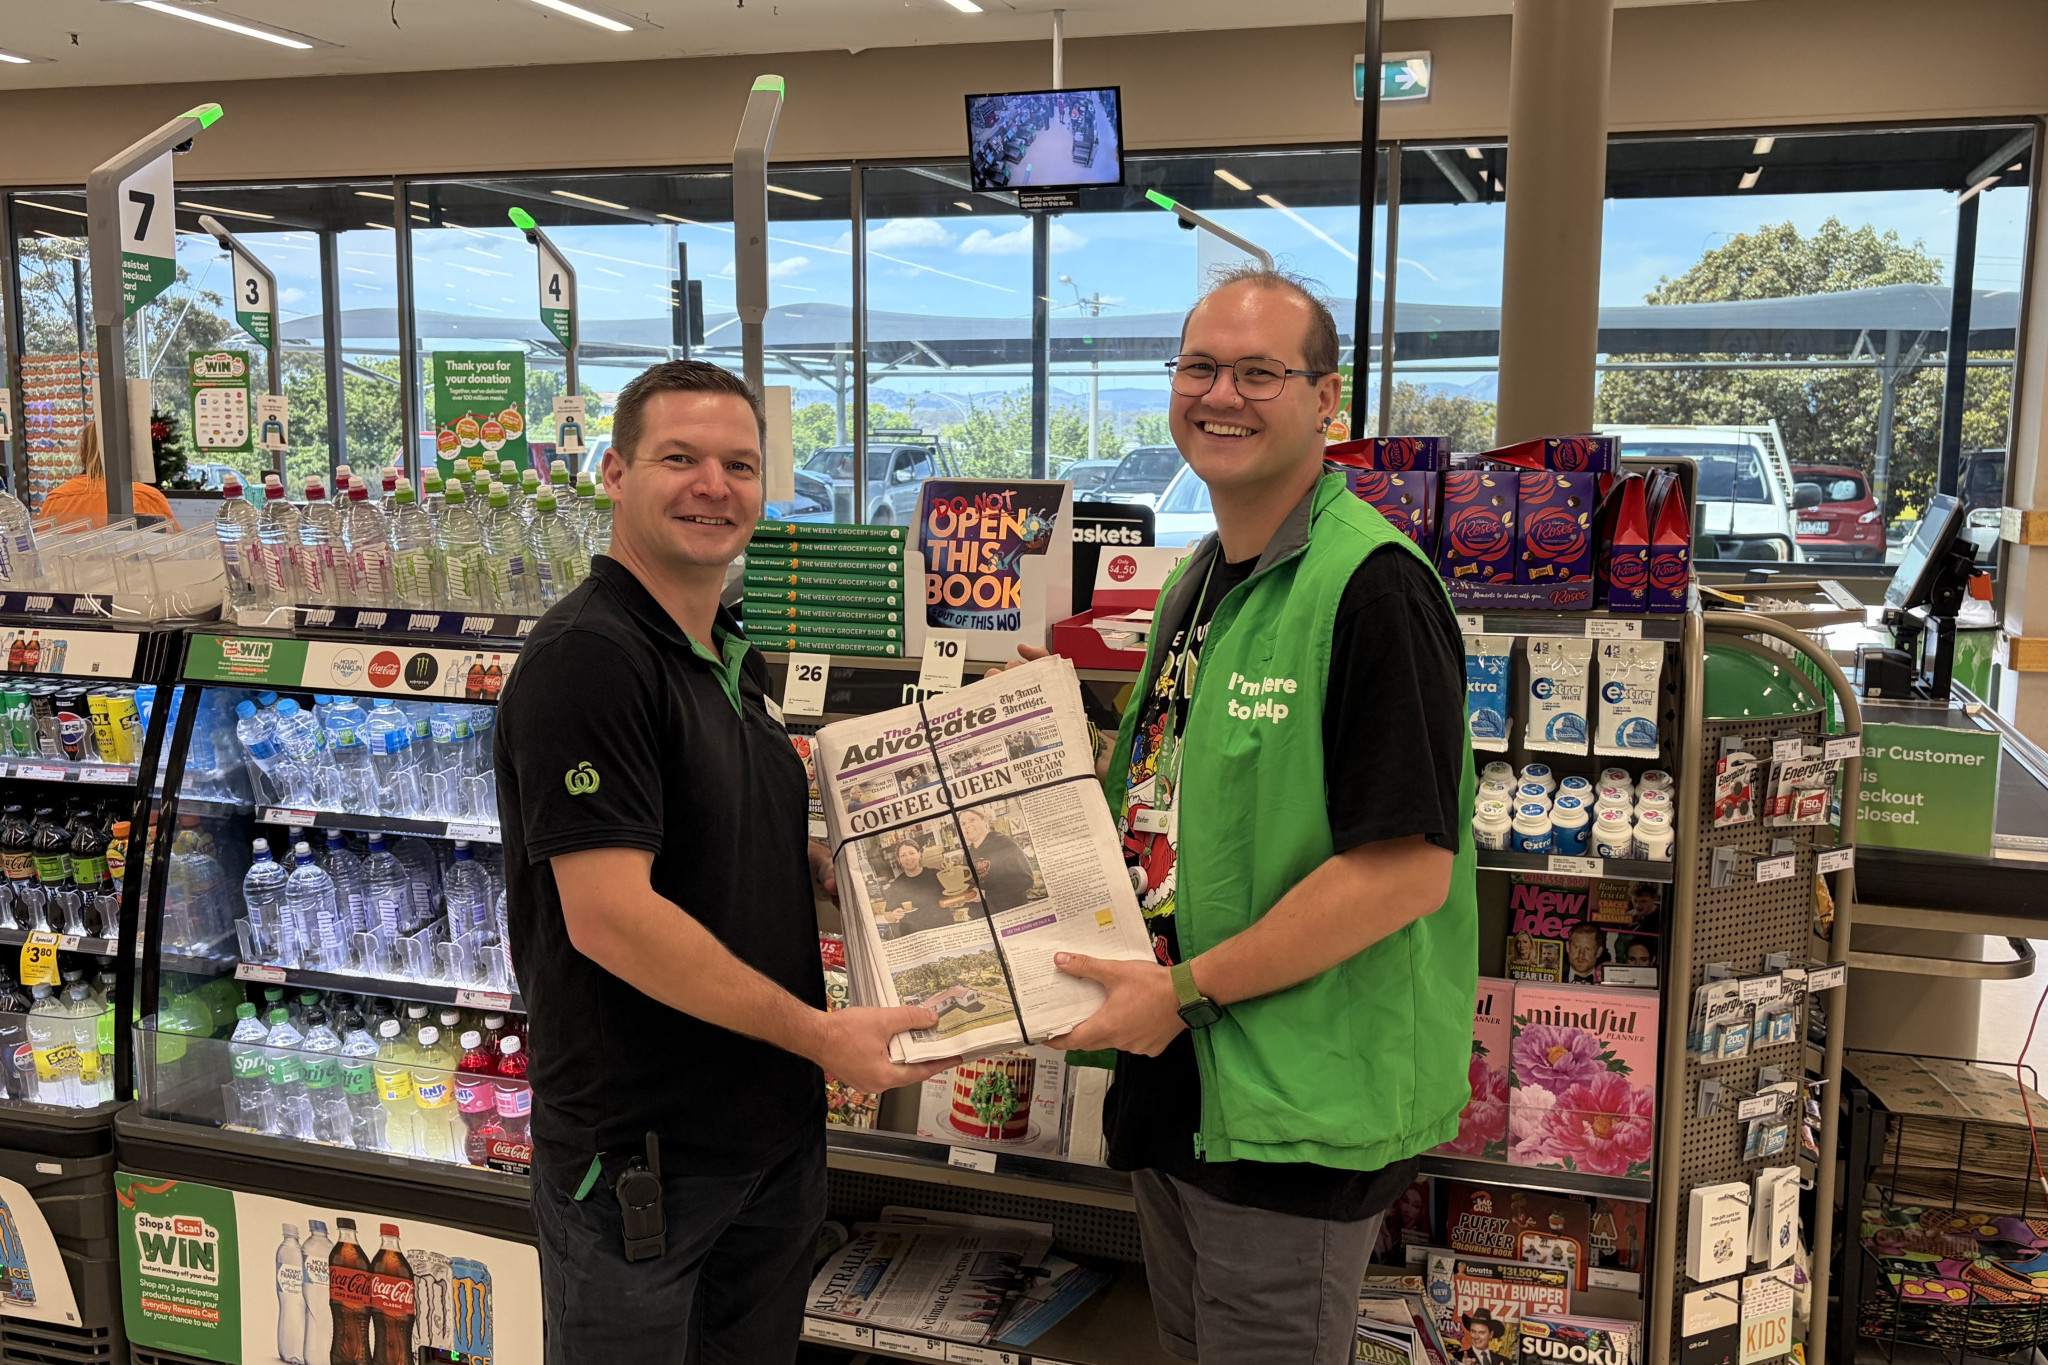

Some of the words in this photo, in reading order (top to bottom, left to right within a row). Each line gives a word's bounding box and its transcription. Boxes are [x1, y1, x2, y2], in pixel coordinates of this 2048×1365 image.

[1021, 195, 1042, 203] Security
[129, 190, 154, 241] 7
[246, 279, 259, 304] 3
[549, 274, 561, 301] 4
[205, 362, 231, 372] WIN
[446, 361, 474, 371] Thank
[476, 363, 494, 375] you
[496, 361, 510, 371] for
[446, 377, 466, 386] your
[468, 374, 511, 383] donation
[933, 497, 968, 518] DO
[975, 490, 1017, 514] NOT
[929, 505, 1026, 540] OPEN
[1457, 521, 1500, 539] Roses
[1532, 521, 1577, 540] Roses
[1072, 524, 1142, 544] askets
[927, 540, 1001, 574] THIS
[1109, 565, 1136, 574] $4.50
[1613, 565, 1643, 576] Roses
[1653, 565, 1683, 576] Roses
[925, 574, 1020, 608] BOOK
[1520, 592, 1530, 600] with
[1550, 590, 1589, 605] Roses
[25, 596, 54, 613] pump
[72, 598, 103, 614] pump
[304, 609, 336, 626] pump
[355, 611, 387, 630] pump
[407, 614, 440, 632] pump
[461, 617, 495, 635] pump
[938, 610, 954, 620] OUT
[956, 613, 968, 626] OF
[971, 615, 994, 630] THIS
[1468, 618, 1476, 626] $5
[1625, 622, 1634, 631] $5
[240, 643, 271, 657] WIN
[933, 640, 958, 658] $10
[1534, 642, 1541, 654] 4
[1542, 642, 1550, 654] PACK
[1605, 645, 1612, 657] 4
[333, 663, 362, 672] FRANKLIN
[369, 663, 398, 675] Coca-Cola
[795, 664, 822, 682] $26
[1228, 672, 1260, 696] I'm
[1536, 682, 1582, 696] extra
[1606, 685, 1652, 700] extra
[999, 694, 1014, 704] The
[1015, 684, 1042, 700] Ararat
[1002, 696, 1047, 718] Advertiser.
[1228, 699, 1251, 720] to
[884, 728, 911, 740] The
[915, 707, 963, 732] Ararat
[840, 707, 996, 770] Advocate
[1013, 762, 1033, 772] BOB
[1034, 755, 1051, 767] SET
[1053, 750, 1066, 760] TO
[1889, 746, 1985, 766] Customer
[1021, 760, 1062, 778] RECLAIM
[1025, 774, 1044, 785] TOP
[1045, 769, 1063, 781] JOB
[1718, 765, 1747, 786] Energizer
[1782, 759, 1836, 782] Energizer
[851, 792, 933, 833] COFFEE
[936, 766, 1012, 806] QUEEN
[1857, 806, 1919, 825] closed.
[1587, 860, 1595, 869] $5
[1522, 874, 1545, 883] WIN!
[1510, 884, 1586, 914] New
[1600, 891, 1625, 899] Irwin
[1512, 909, 1582, 939] Idea
[1539, 974, 1554, 982] LED
[1527, 1006, 1636, 1035] mindful
[1606, 1033, 1645, 1042] PLANNER
[419, 1084, 447, 1096] FANTA
[493, 1141, 530, 1160] Coca-Cola
[139, 1217, 163, 1231] Shop
[165, 1222, 172, 1231] &
[177, 1222, 200, 1234] Scan
[205, 1229, 215, 1238] to
[1459, 1213, 1509, 1233] PUFFY
[1710, 1219, 1730, 1227] everything
[1730, 1216, 1741, 1224] Apple
[1452, 1227, 1515, 1250] STICKER
[139, 1231, 215, 1272] WIN
[1452, 1241, 1492, 1255] COLOURING
[1493, 1247, 1513, 1257] BOOK
[142, 1264, 161, 1272] Instant
[162, 1268, 180, 1277] money
[203, 1274, 216, 1282] shop
[813, 1237, 877, 1313] AUSTRALIAN
[1466, 1265, 1493, 1276] Lovatts
[140, 1279, 157, 1289] Shop
[158, 1283, 169, 1291] any
[176, 1286, 219, 1300] participating
[330, 1270, 371, 1295] Coca-Cola
[372, 1276, 414, 1304] Coca-Cola
[1457, 1280, 1508, 1300] VARIETY
[1511, 1284, 1564, 1304] BUMPER
[142, 1290, 171, 1301] products
[172, 1294, 185, 1303] and
[202, 1300, 217, 1309] your
[142, 1300, 171, 1312] Everyday
[173, 1305, 200, 1316] Rewards
[202, 1310, 219, 1319] Card
[924, 1295, 949, 1325] climate
[169, 1315, 192, 1325] chance
[1747, 1316, 1786, 1353] KIDS
[1522, 1336, 1623, 1365] SUDOKU
